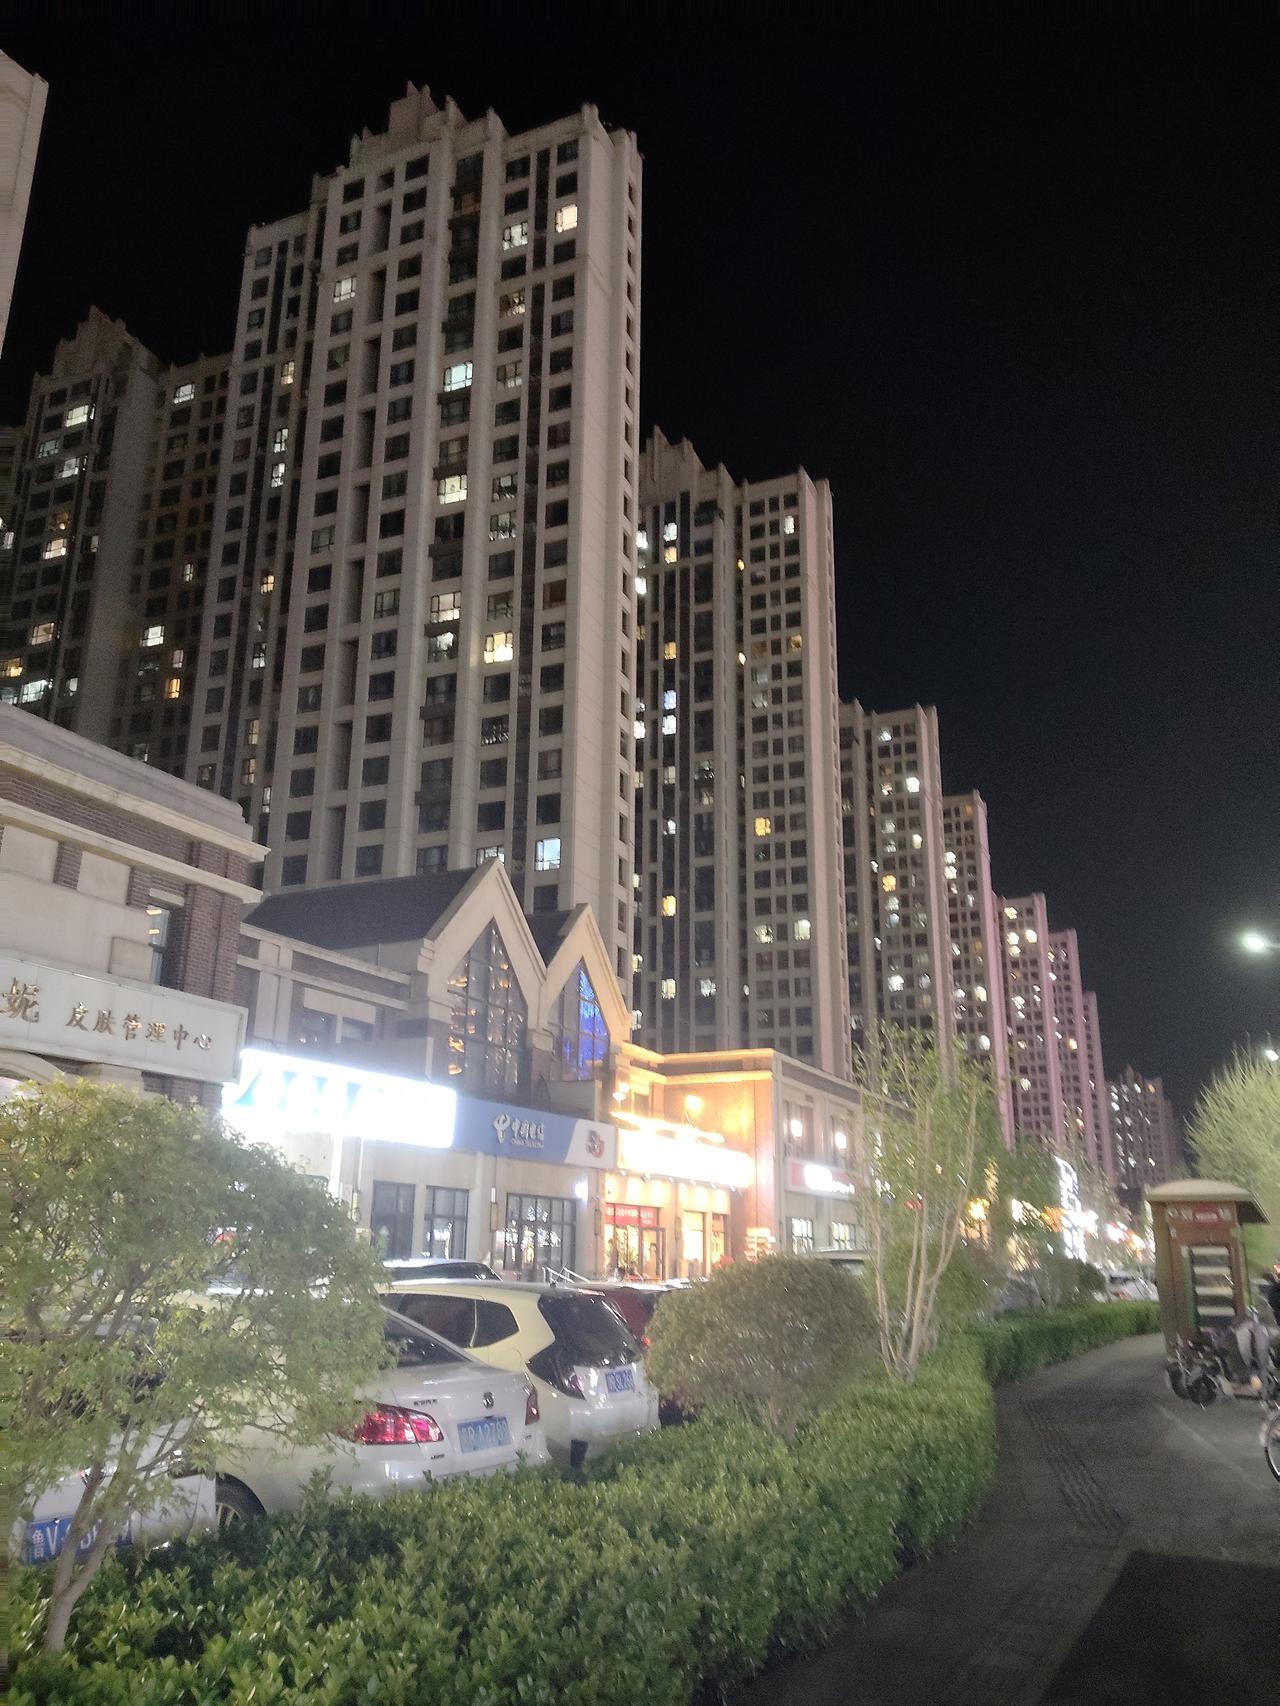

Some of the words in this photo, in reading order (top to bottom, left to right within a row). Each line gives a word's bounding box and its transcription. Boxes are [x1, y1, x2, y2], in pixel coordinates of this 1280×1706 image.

[65, 1002, 212, 1050] 皮肤管理中心
